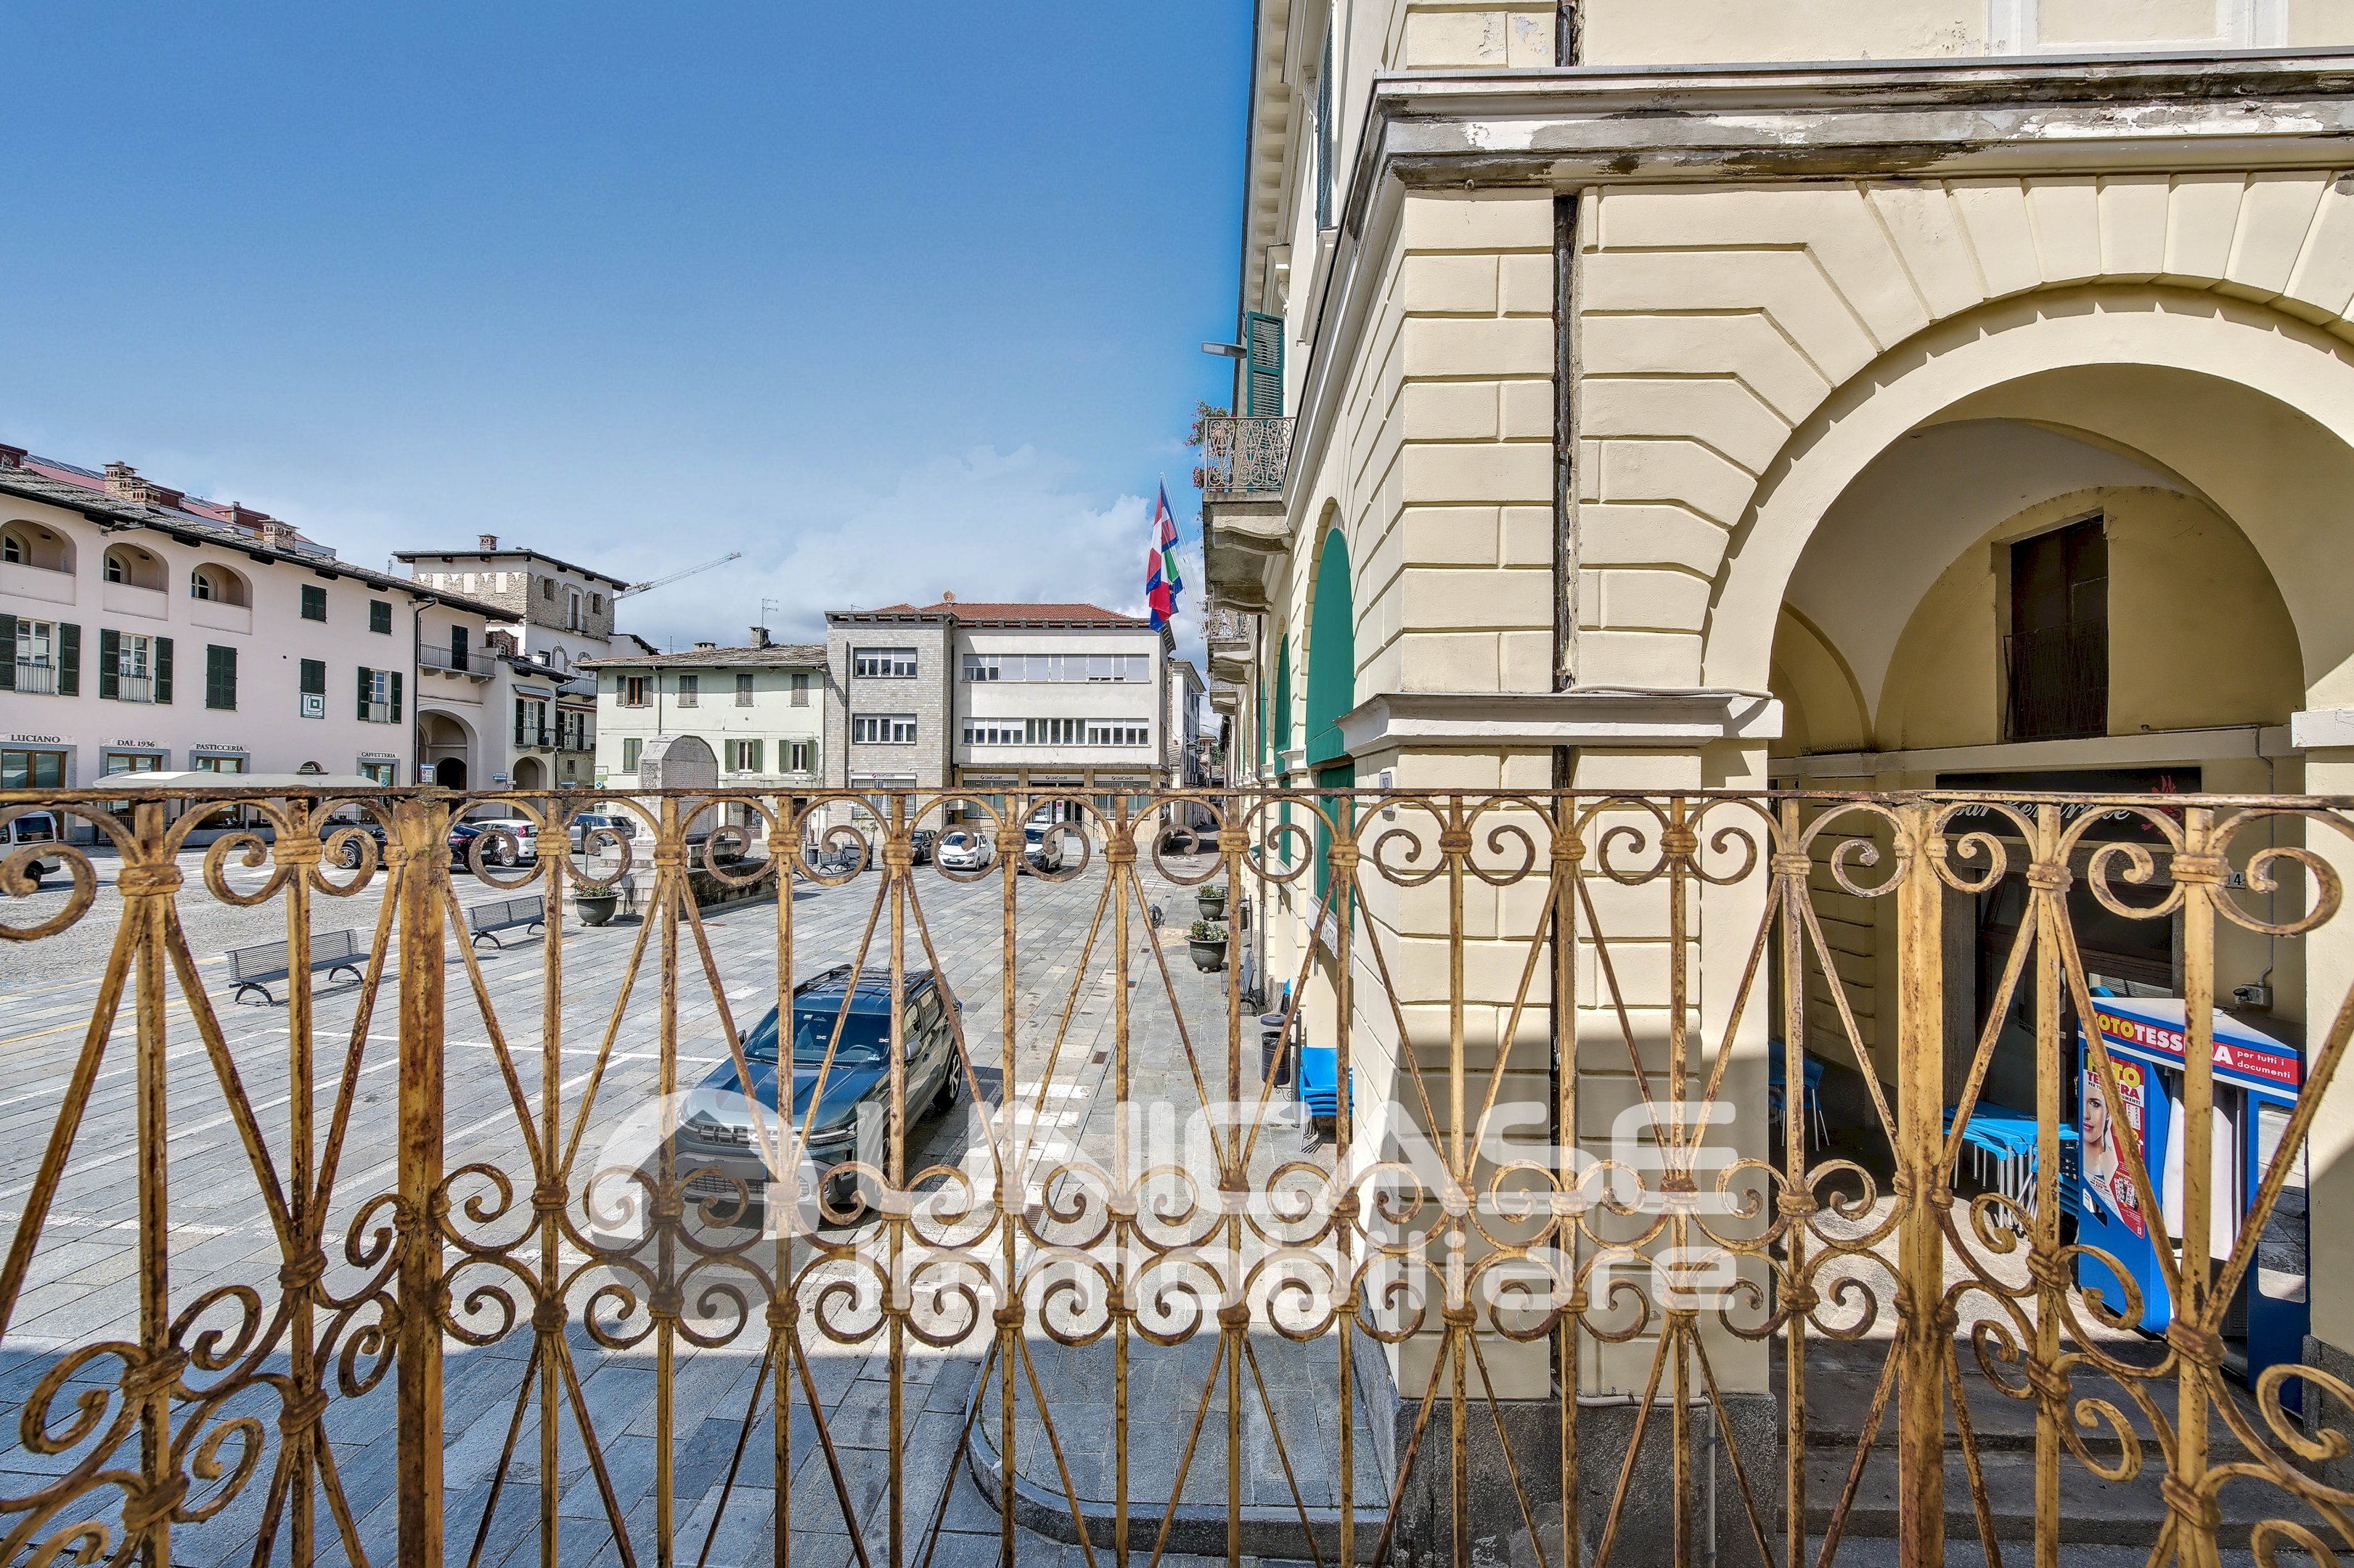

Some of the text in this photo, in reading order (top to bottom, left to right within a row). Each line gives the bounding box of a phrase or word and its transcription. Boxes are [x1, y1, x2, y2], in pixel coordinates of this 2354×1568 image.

[11, 734, 60, 743] LUCIANO
[196, 743, 244, 752] PASTICCERIA
[2236, 1050, 2254, 1059] per
[2257, 1053, 2278, 1064] tutti
[2087, 1052, 2141, 1088] FTO
[2236, 1060, 2291, 1079] documenti
